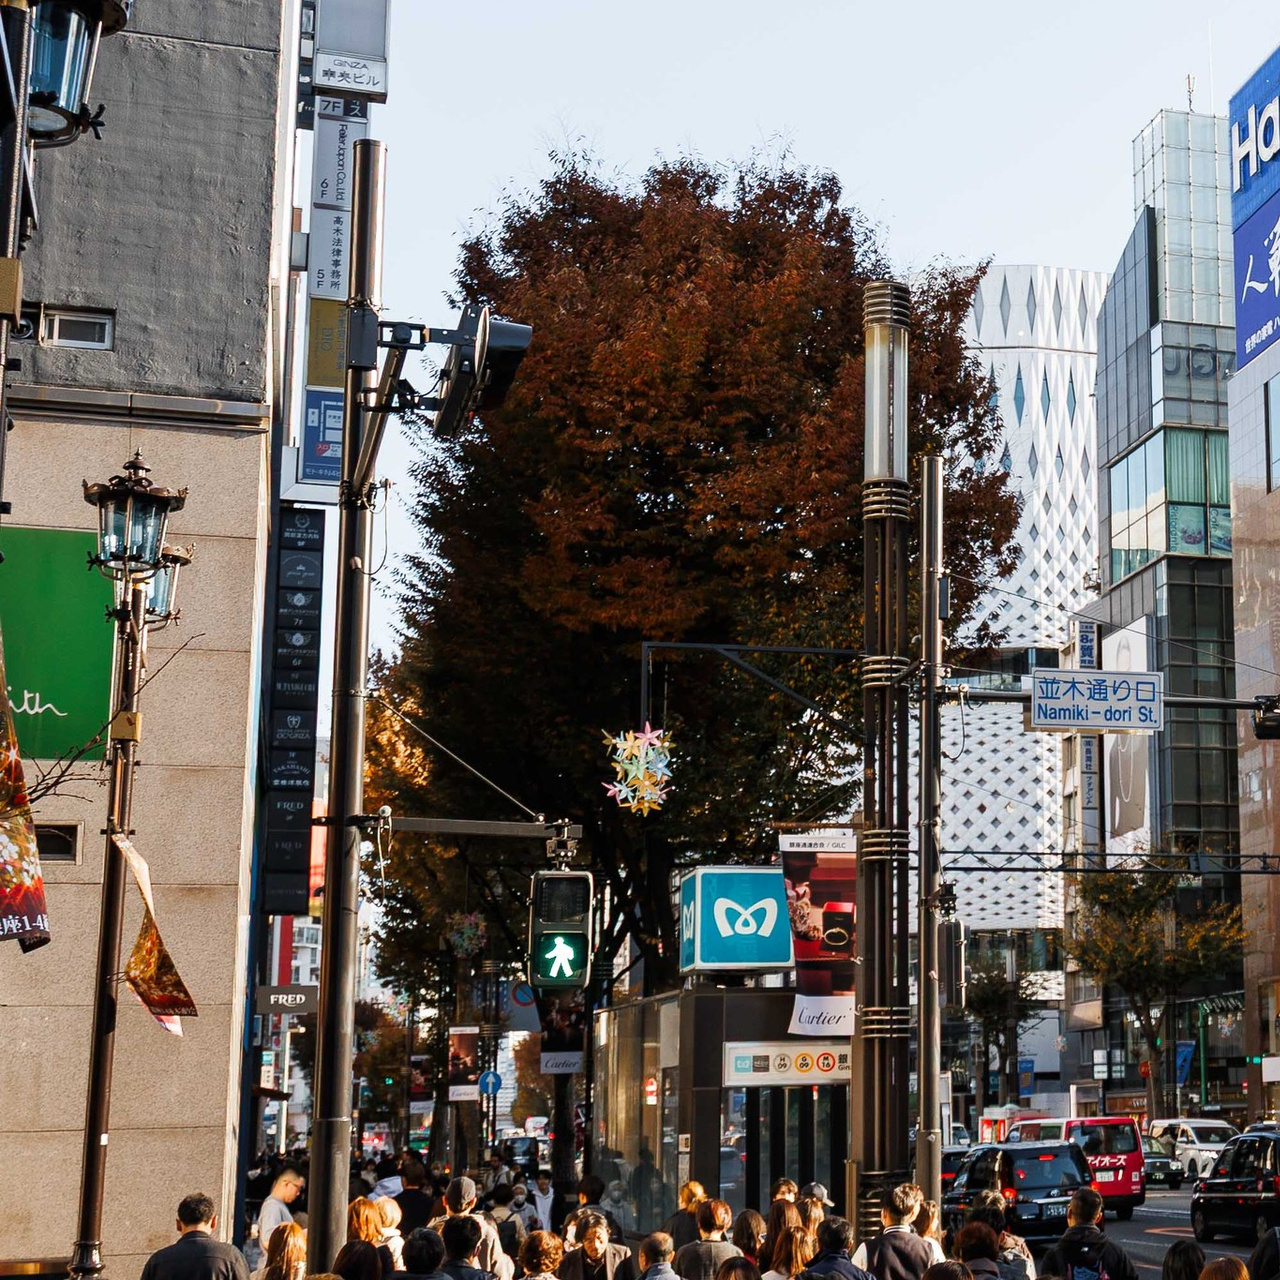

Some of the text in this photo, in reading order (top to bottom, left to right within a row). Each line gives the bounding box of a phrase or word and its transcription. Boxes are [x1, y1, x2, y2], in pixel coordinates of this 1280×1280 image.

[333, 59, 369, 70] GINZA
[321, 100, 342, 112] 7F
[1038, 676, 1156, 702] 並木通り口
[1138, 706, 1158, 723] St.
[277, 801, 304, 812] FRED
[270, 994, 306, 1007] FRED
[798, 1006, 846, 1026] Cartier
[544, 1057, 580, 1070] Cartier
